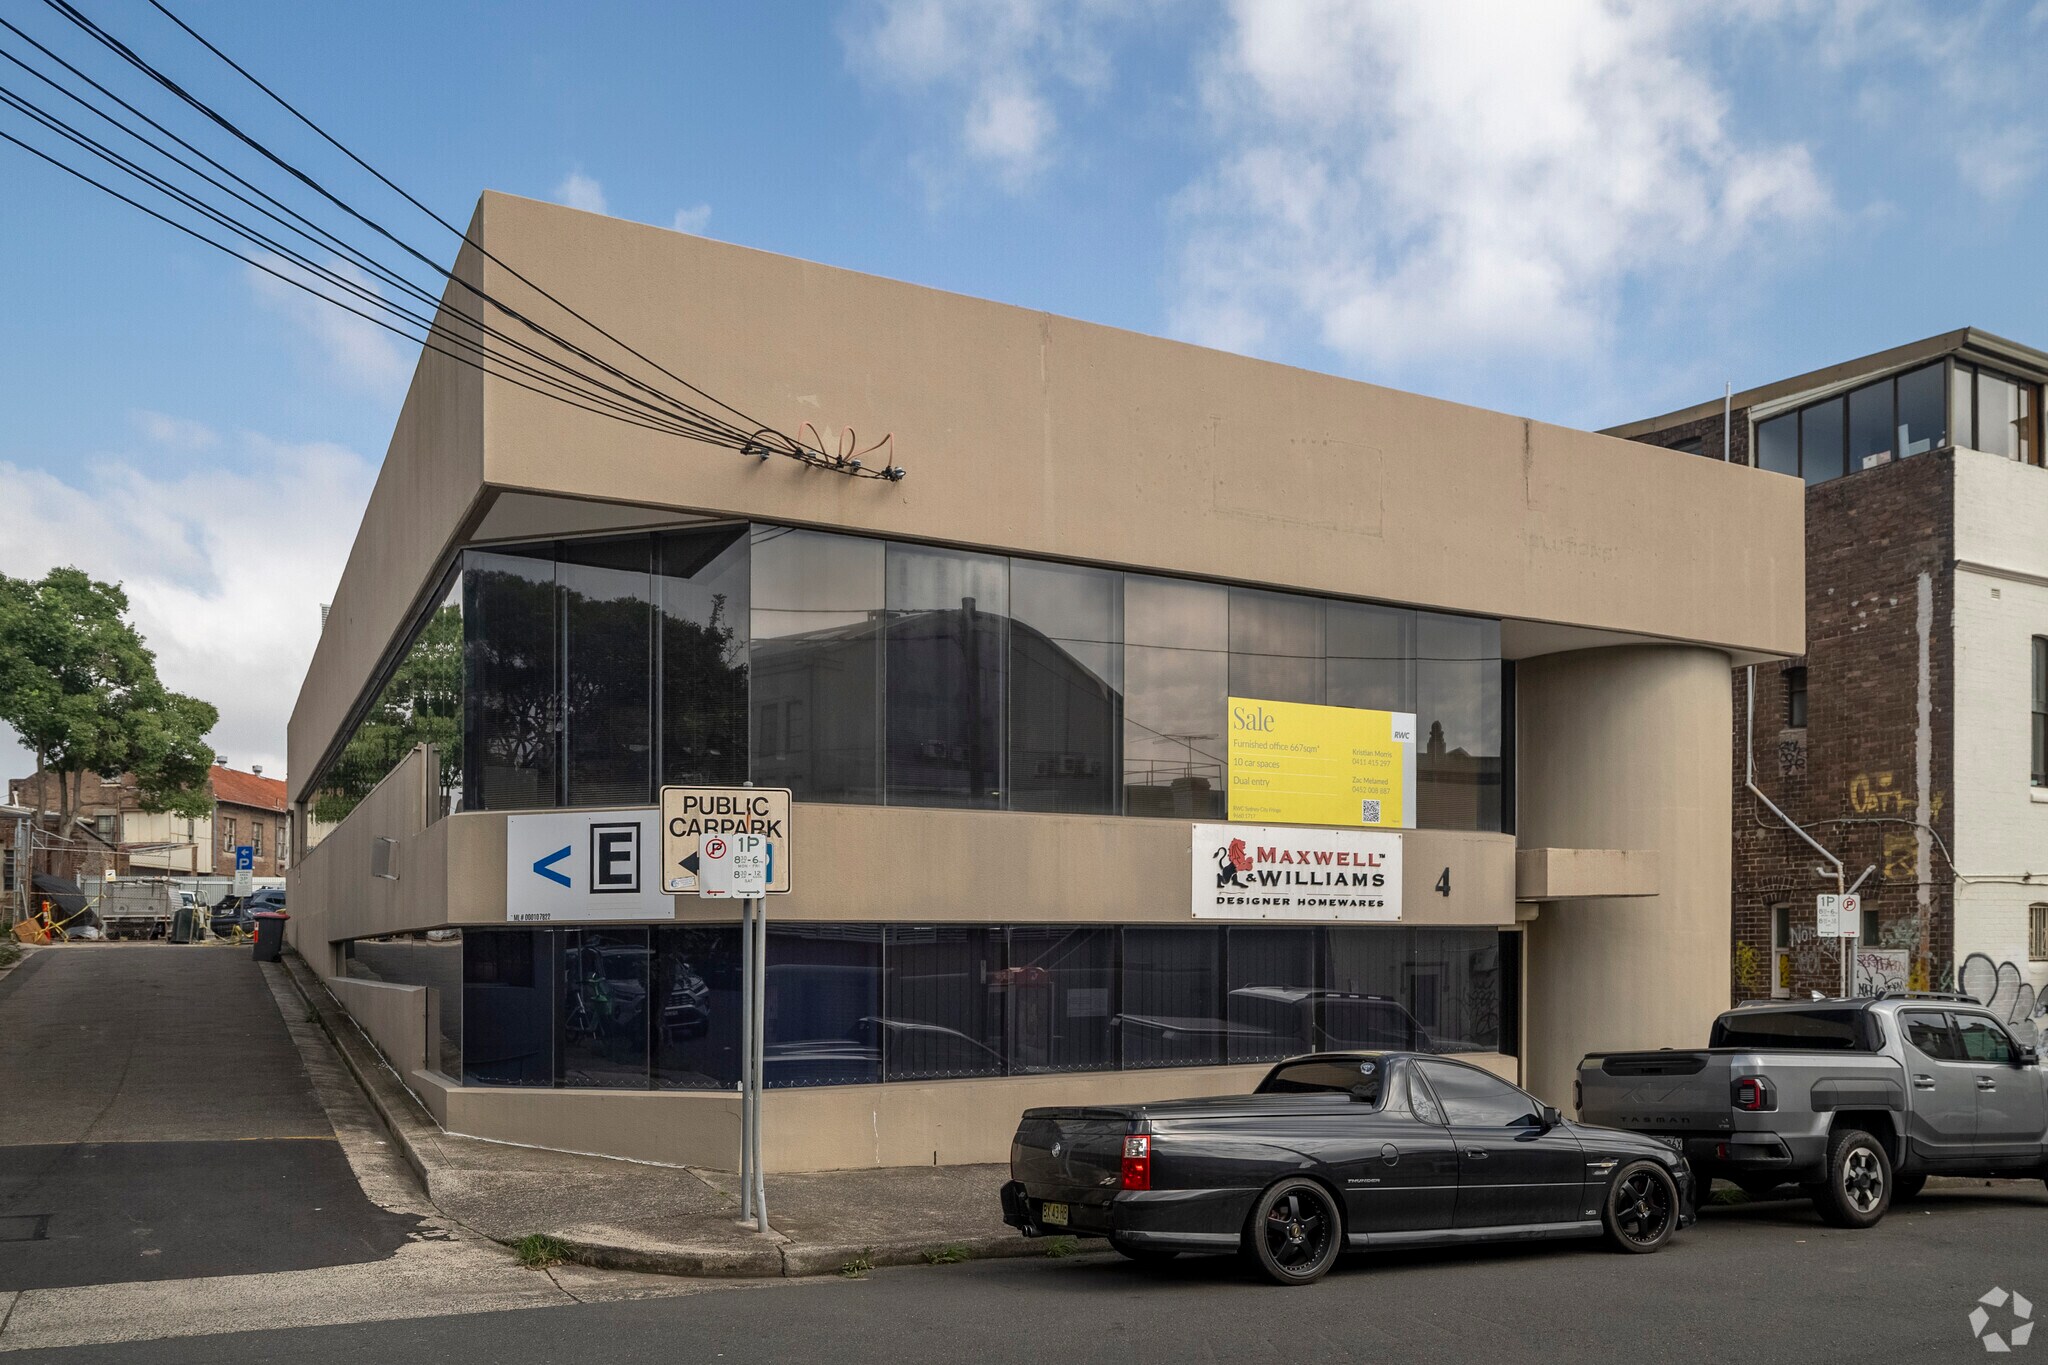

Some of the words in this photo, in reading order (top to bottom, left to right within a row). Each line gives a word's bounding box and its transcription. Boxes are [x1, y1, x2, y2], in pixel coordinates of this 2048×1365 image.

[1233, 706, 1275, 732] Sale
[1394, 731, 1410, 740] RWC
[1233, 739, 1268, 750] Furnished
[1269, 742, 1289, 751] office
[1352, 748, 1374, 756] Kristian
[1375, 750, 1392, 758] Morris
[1234, 757, 1243, 766] 10
[1244, 759, 1255, 767] car
[1257, 760, 1280, 769] spaces
[1352, 758, 1366, 766] 0411
[1233, 776, 1250, 786] Dual
[1251, 777, 1270, 787] entry
[1352, 776, 1362, 784] Zac
[683, 796, 769, 816] PUBLIC
[669, 817, 782, 838] CARPARK
[738, 836, 760, 852] 1P
[599, 832, 632, 885] E
[1256, 846, 1382, 867] MAXWELL
[239, 858, 250, 870] P
[1257, 870, 1385, 887] WILLIAMS
[1435, 866, 1451, 897] 4
[1216, 896, 1290, 906] DESIGNER
[1297, 898, 1384, 907] HOMEWARES
[1821, 896, 1835, 907] 1P
[1620, 1116, 1691, 1124] TASMAN
